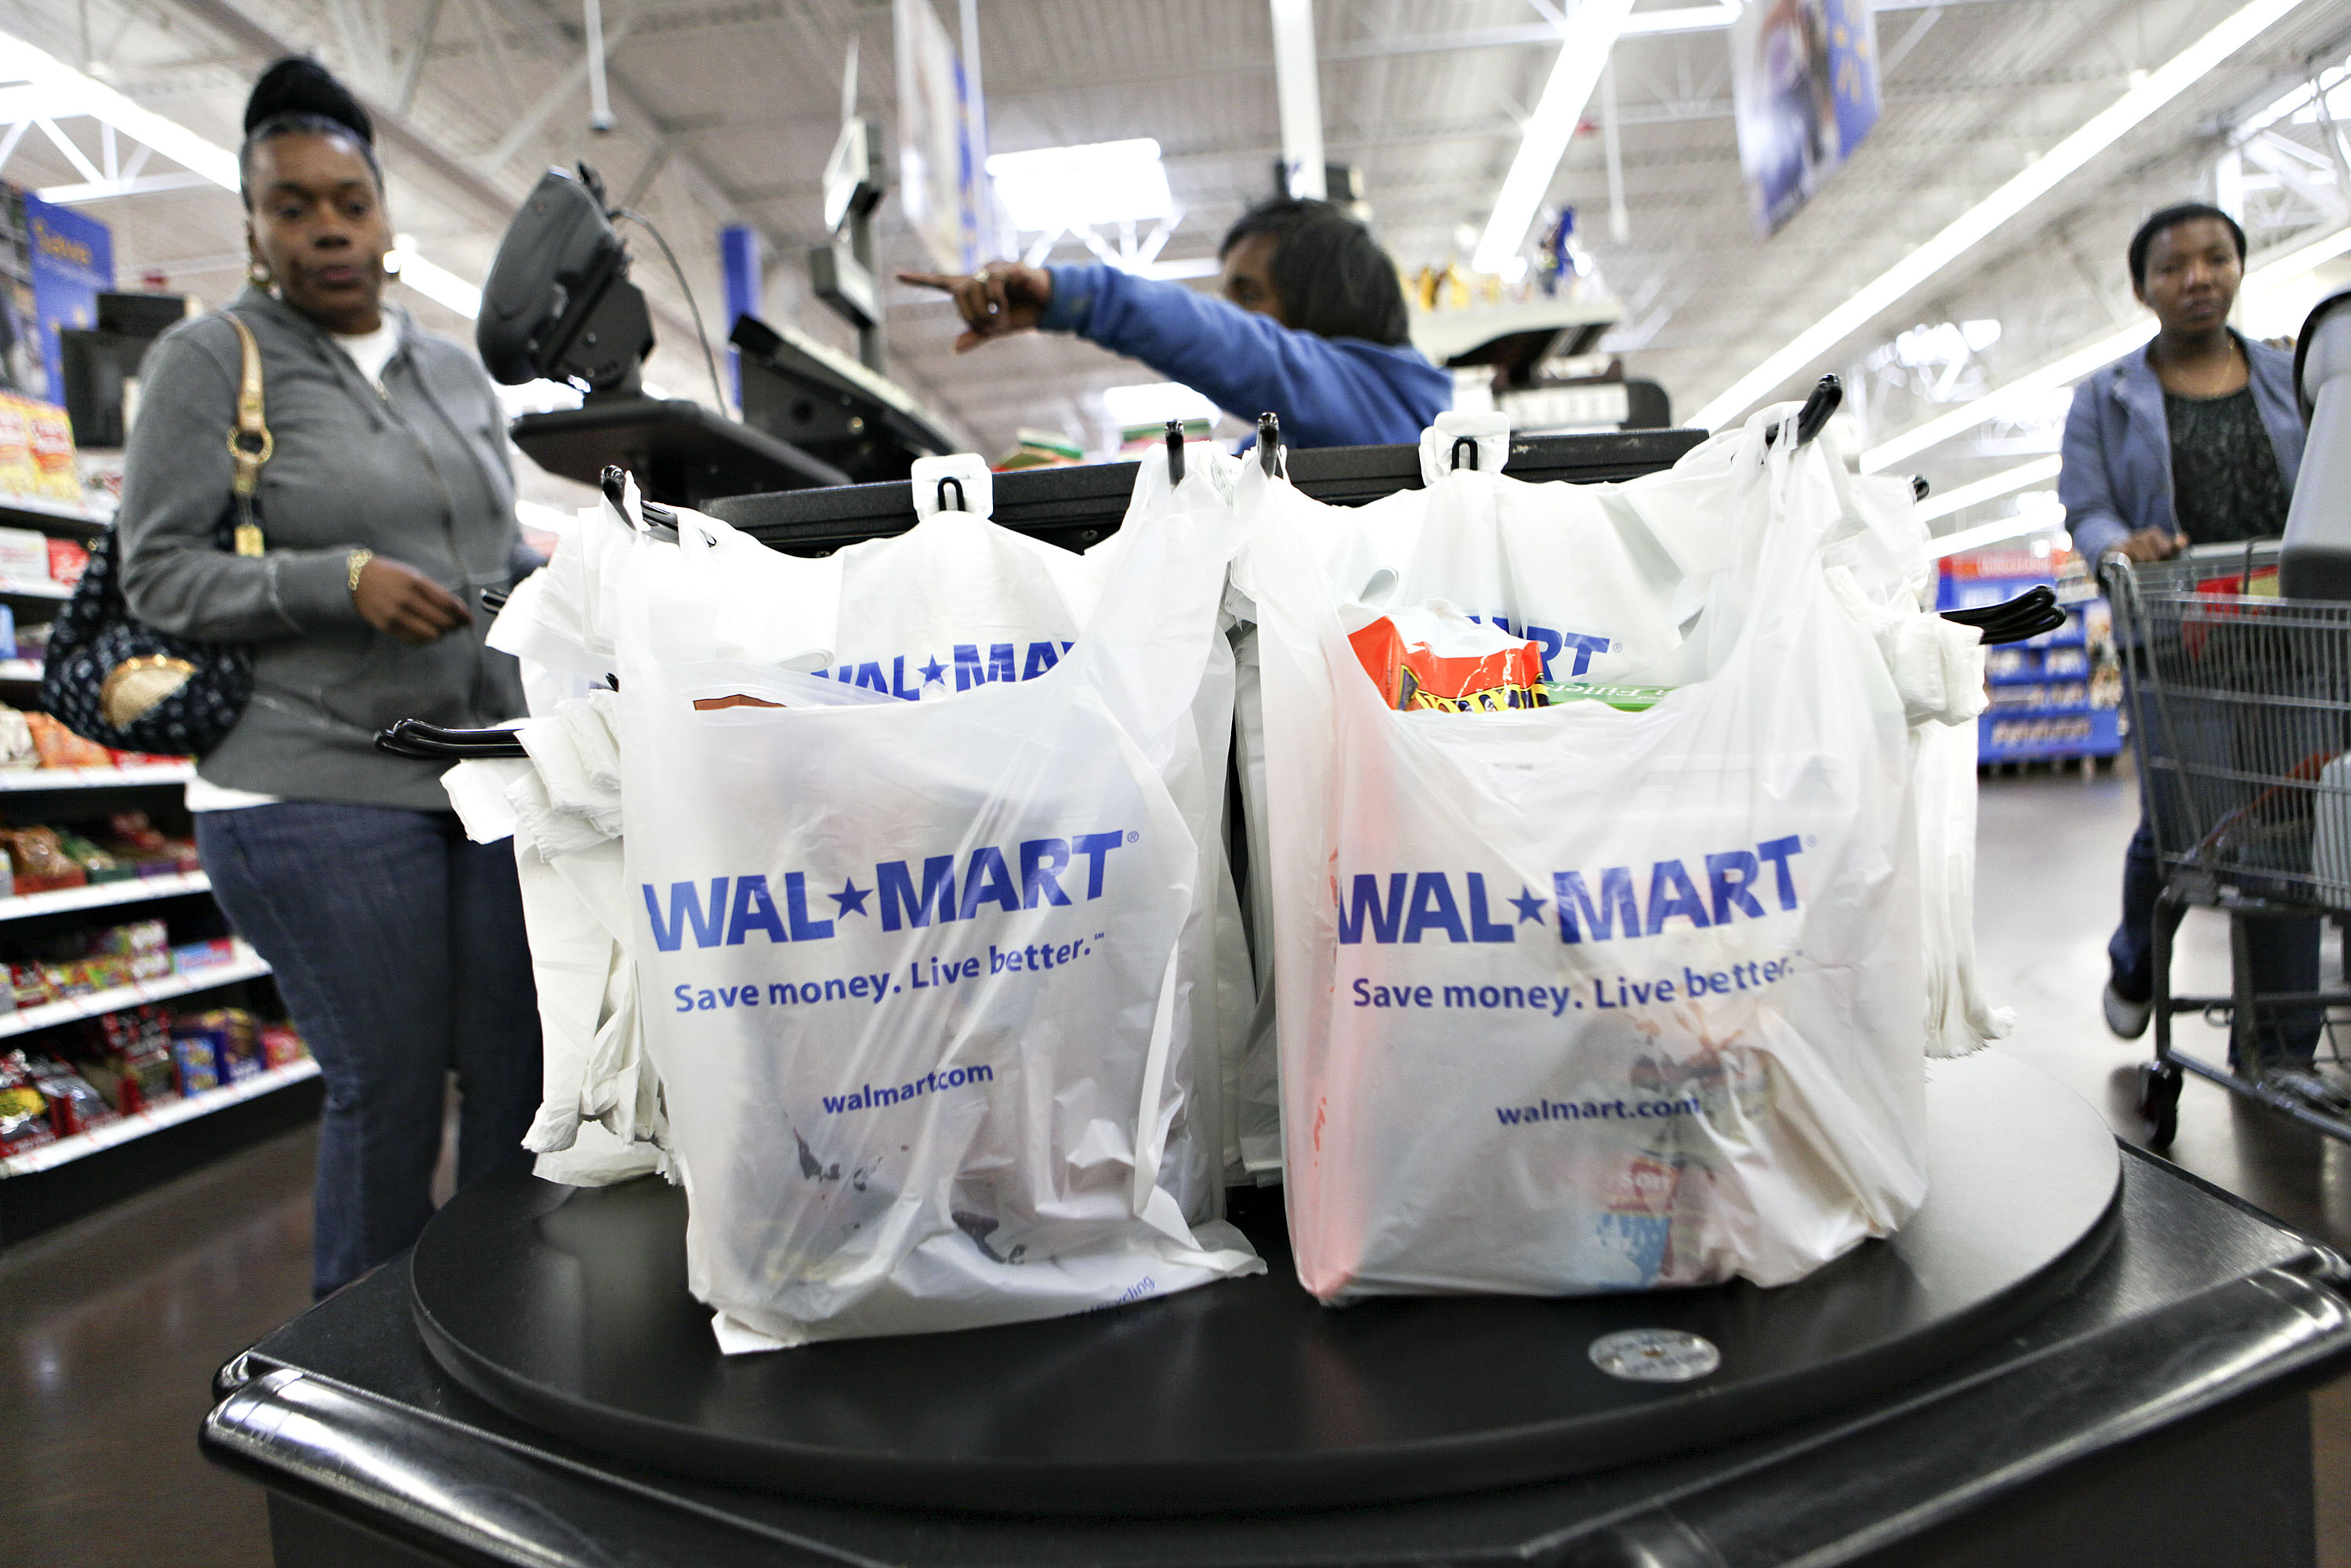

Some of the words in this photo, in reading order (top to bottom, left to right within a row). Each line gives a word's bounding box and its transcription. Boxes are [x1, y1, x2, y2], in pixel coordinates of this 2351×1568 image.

[675, 983, 760, 1012] Save
[769, 972, 902, 1005] money.
[911, 956, 980, 990] Live
[990, 937, 1092, 976] better.
[1353, 977, 1433, 1009] Save
[1443, 983, 1583, 1017] money.
[1594, 976, 1675, 1009] Live
[1683, 956, 1795, 998] better.
[1494, 1097, 1701, 1125] walmart.com
